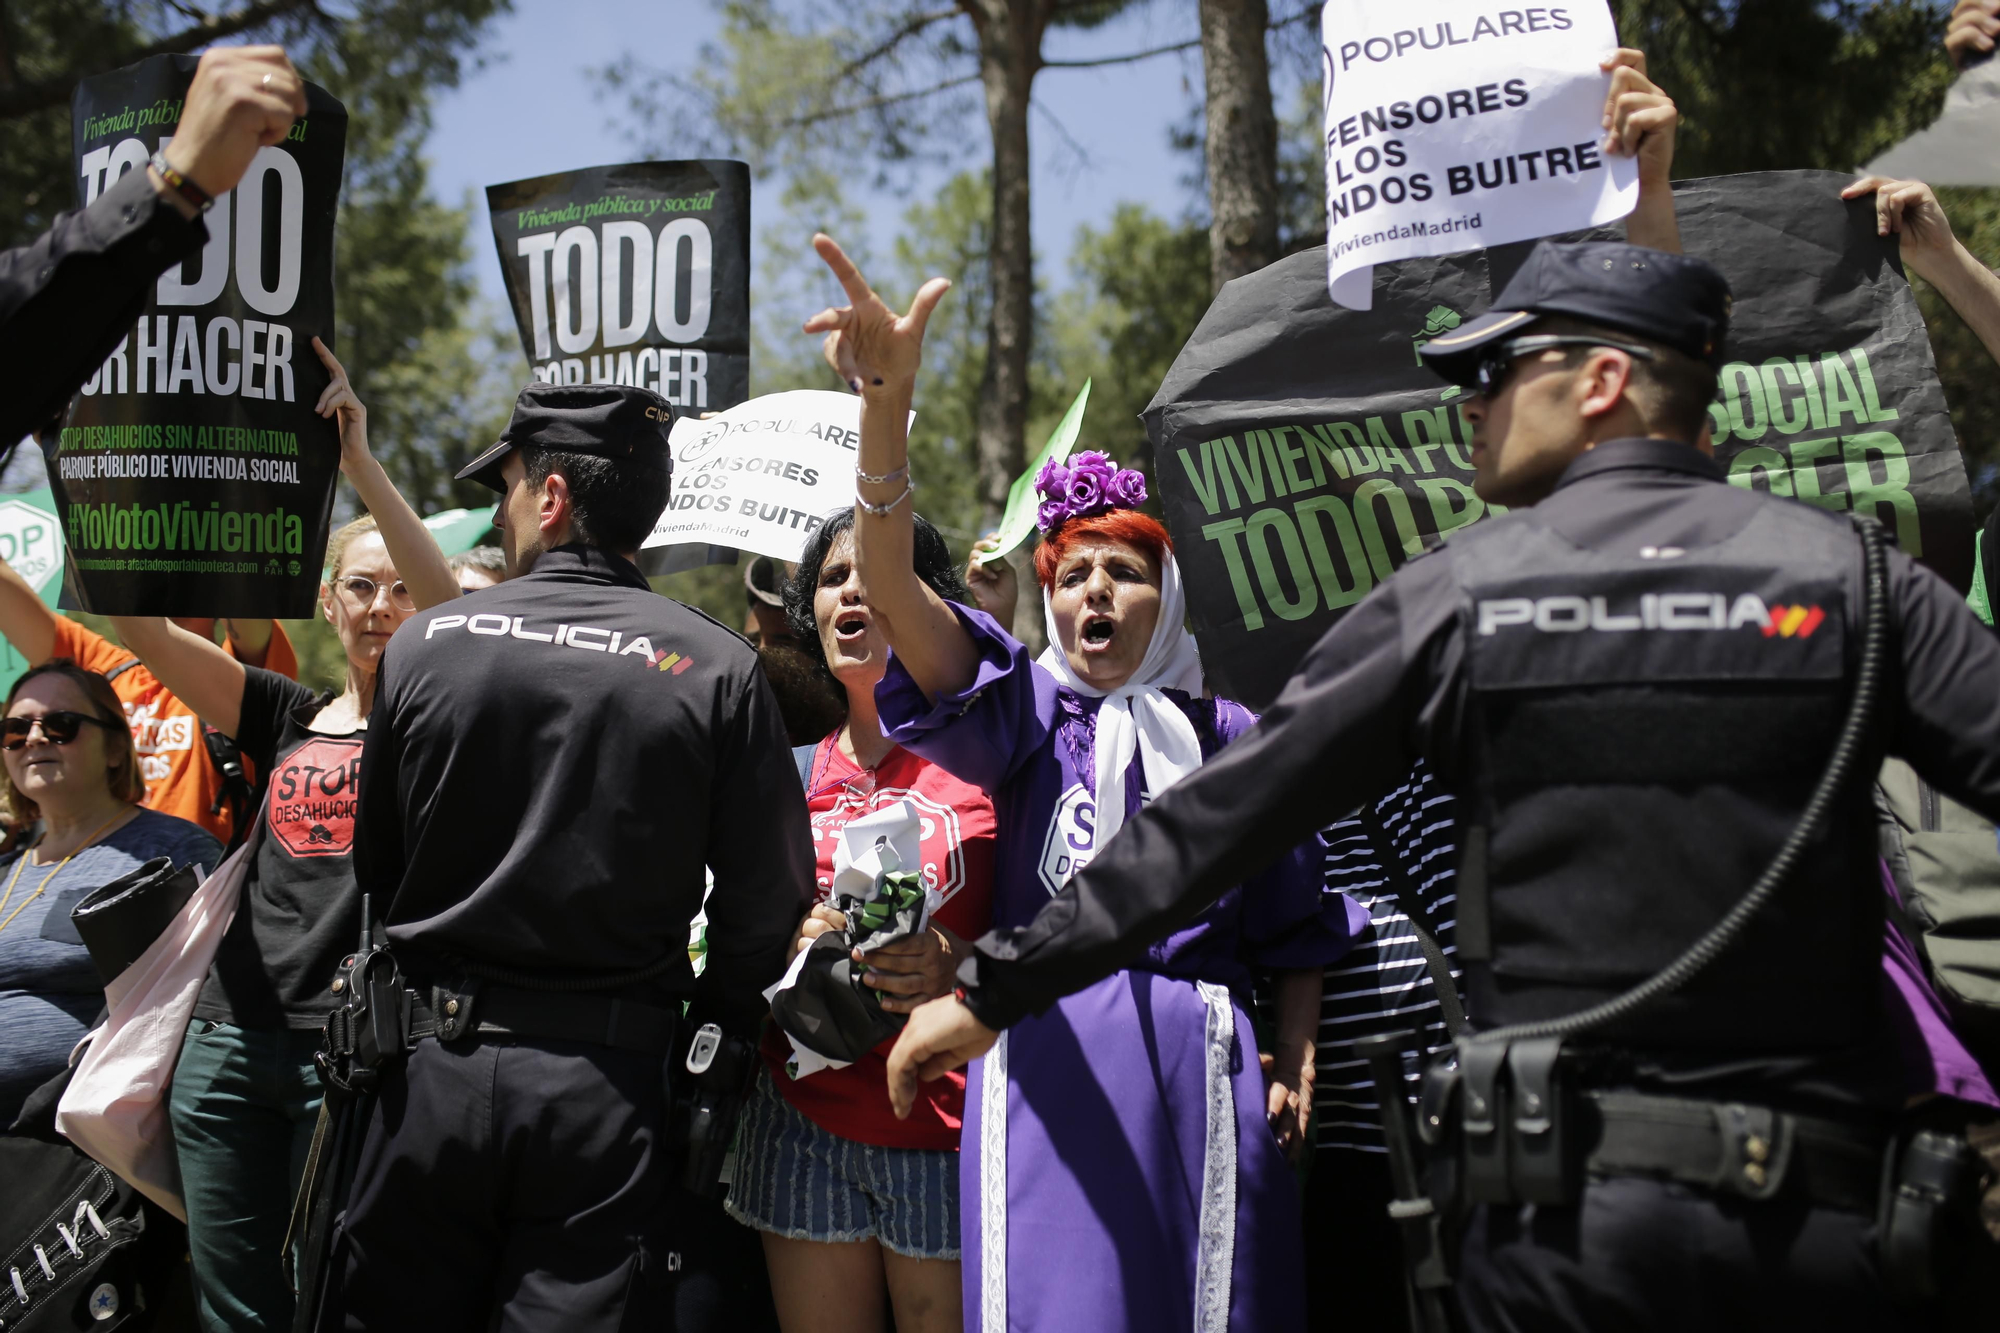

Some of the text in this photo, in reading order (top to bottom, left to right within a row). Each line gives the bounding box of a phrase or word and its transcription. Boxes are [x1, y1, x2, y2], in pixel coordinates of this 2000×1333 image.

[1340, 8, 1574, 72] POPULARES
[83, 99, 182, 142] Vivienda públ
[1335, 140, 1407, 186] LOS
[1447, 140, 1602, 196] BUITRE
[517, 191, 715, 231] Vivienda pública y social
[517, 217, 713, 361] TODO
[136, 314, 296, 402] HACER
[645, 406, 670, 423] CNP
[728, 419, 860, 452] POPULARE
[60, 424, 299, 456] STOP DESAHUCIOS SIN ALTERNATIVA
[60, 449, 301, 484] PARQUE PÚBLICO DE VIVIENDA SOCIAL
[678, 473, 729, 490] LOS
[1177, 415, 1416, 517] VIVIENDA
[67, 500, 303, 555] #YoVotoVivienda
[127, 557, 258, 574] afectadosporlahipoteca.com
[264, 567, 283, 576] PAH
[1201, 477, 1427, 632] TODO
[1478, 593, 1773, 636] POLICIA
[424, 613, 657, 663] POLICIA
